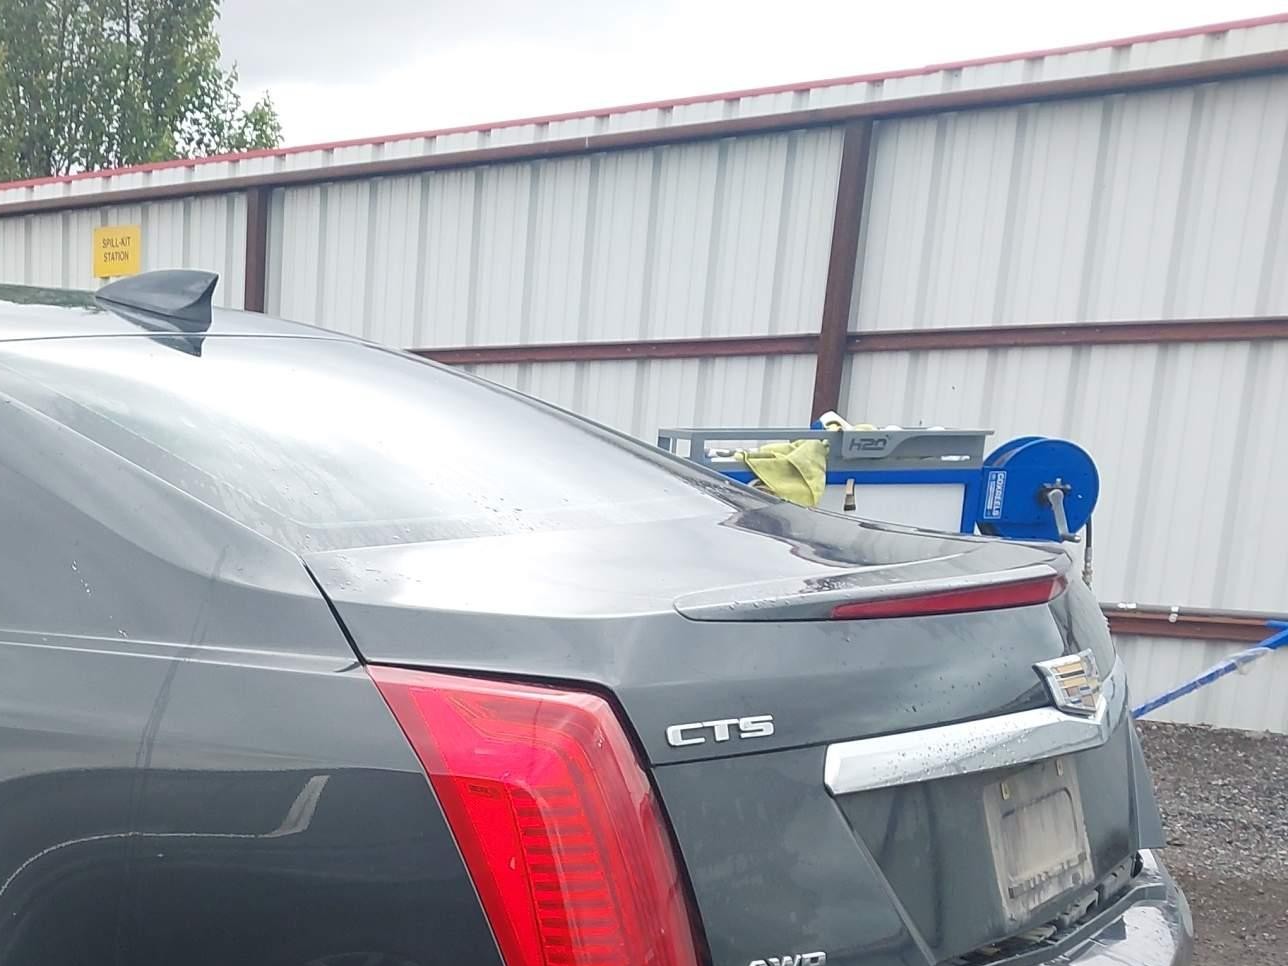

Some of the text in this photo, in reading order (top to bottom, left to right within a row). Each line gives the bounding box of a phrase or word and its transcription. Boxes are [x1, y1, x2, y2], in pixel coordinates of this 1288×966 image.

[102, 236, 131, 248] SPILL-KIT
[103, 250, 129, 262] STATION
[665, 714, 775, 747] CTS
